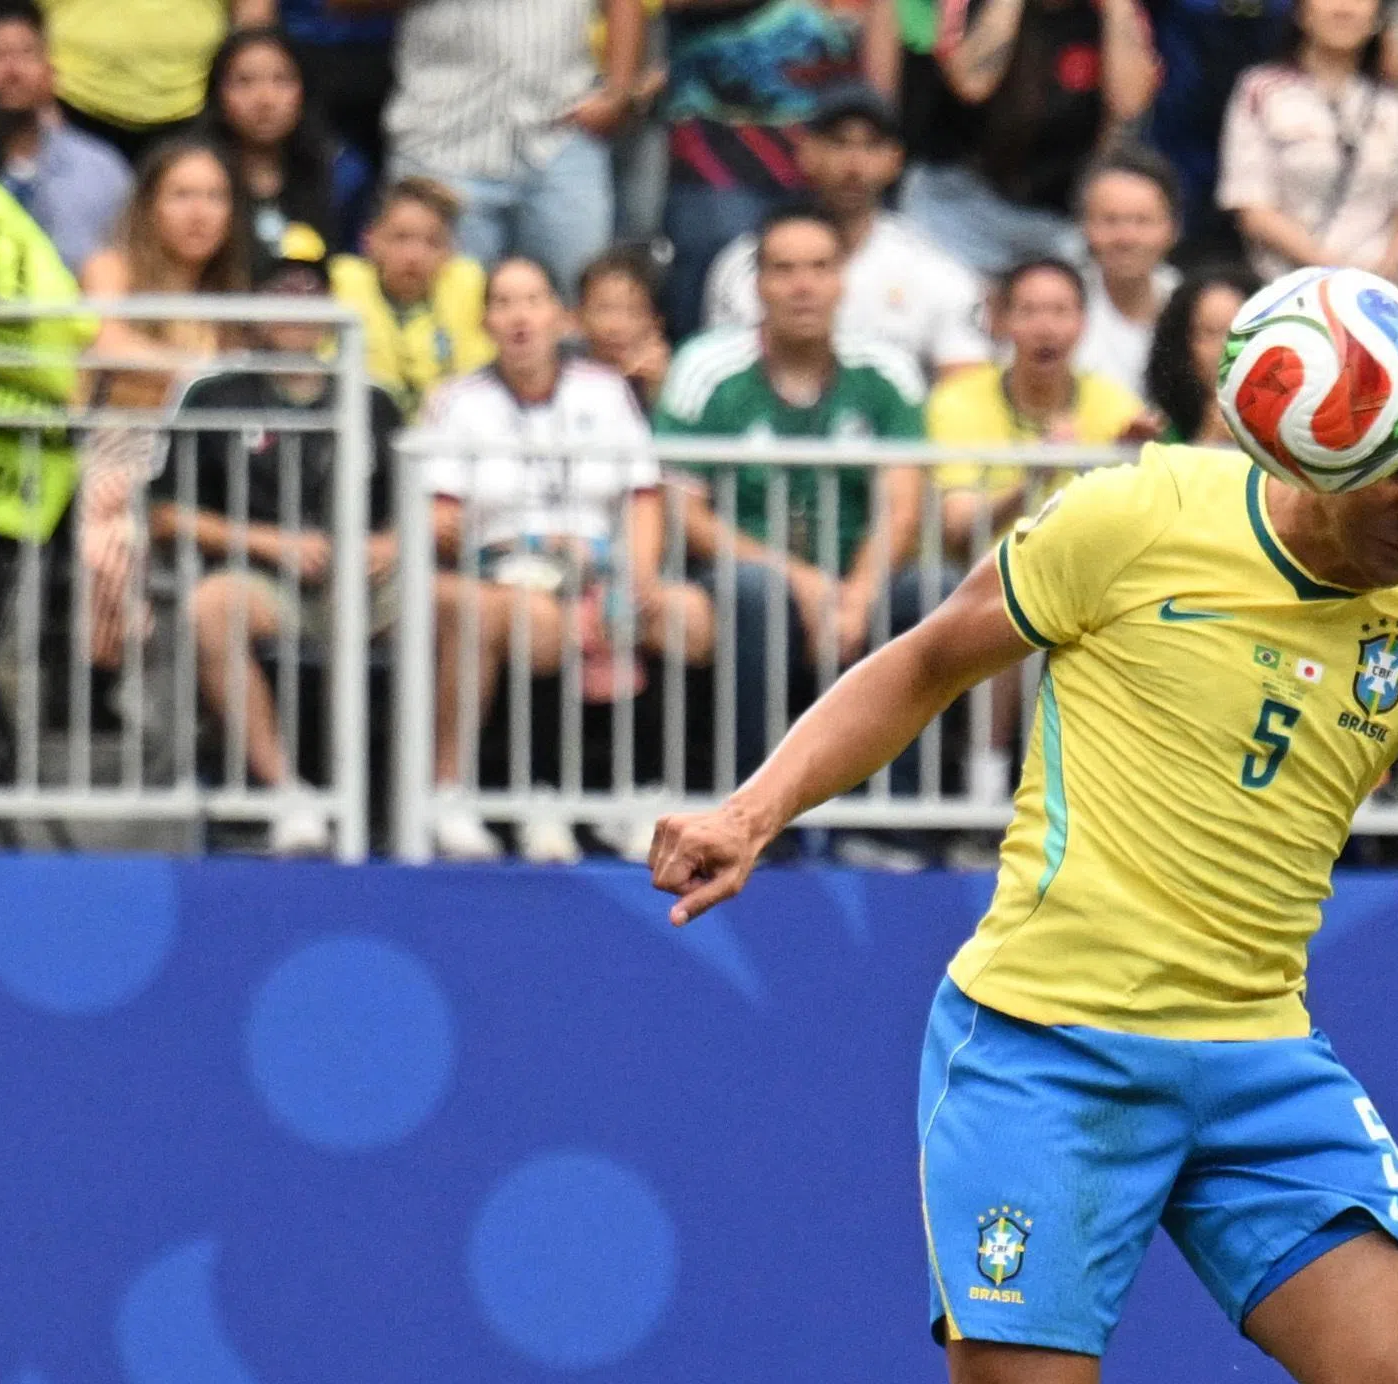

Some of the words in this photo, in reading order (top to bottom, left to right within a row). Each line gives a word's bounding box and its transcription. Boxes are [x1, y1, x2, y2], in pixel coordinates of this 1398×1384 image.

[1337, 711, 1389, 742] BRASIL
[1241, 698, 1301, 788] 5
[969, 1286, 1026, 1304] BRASIL
